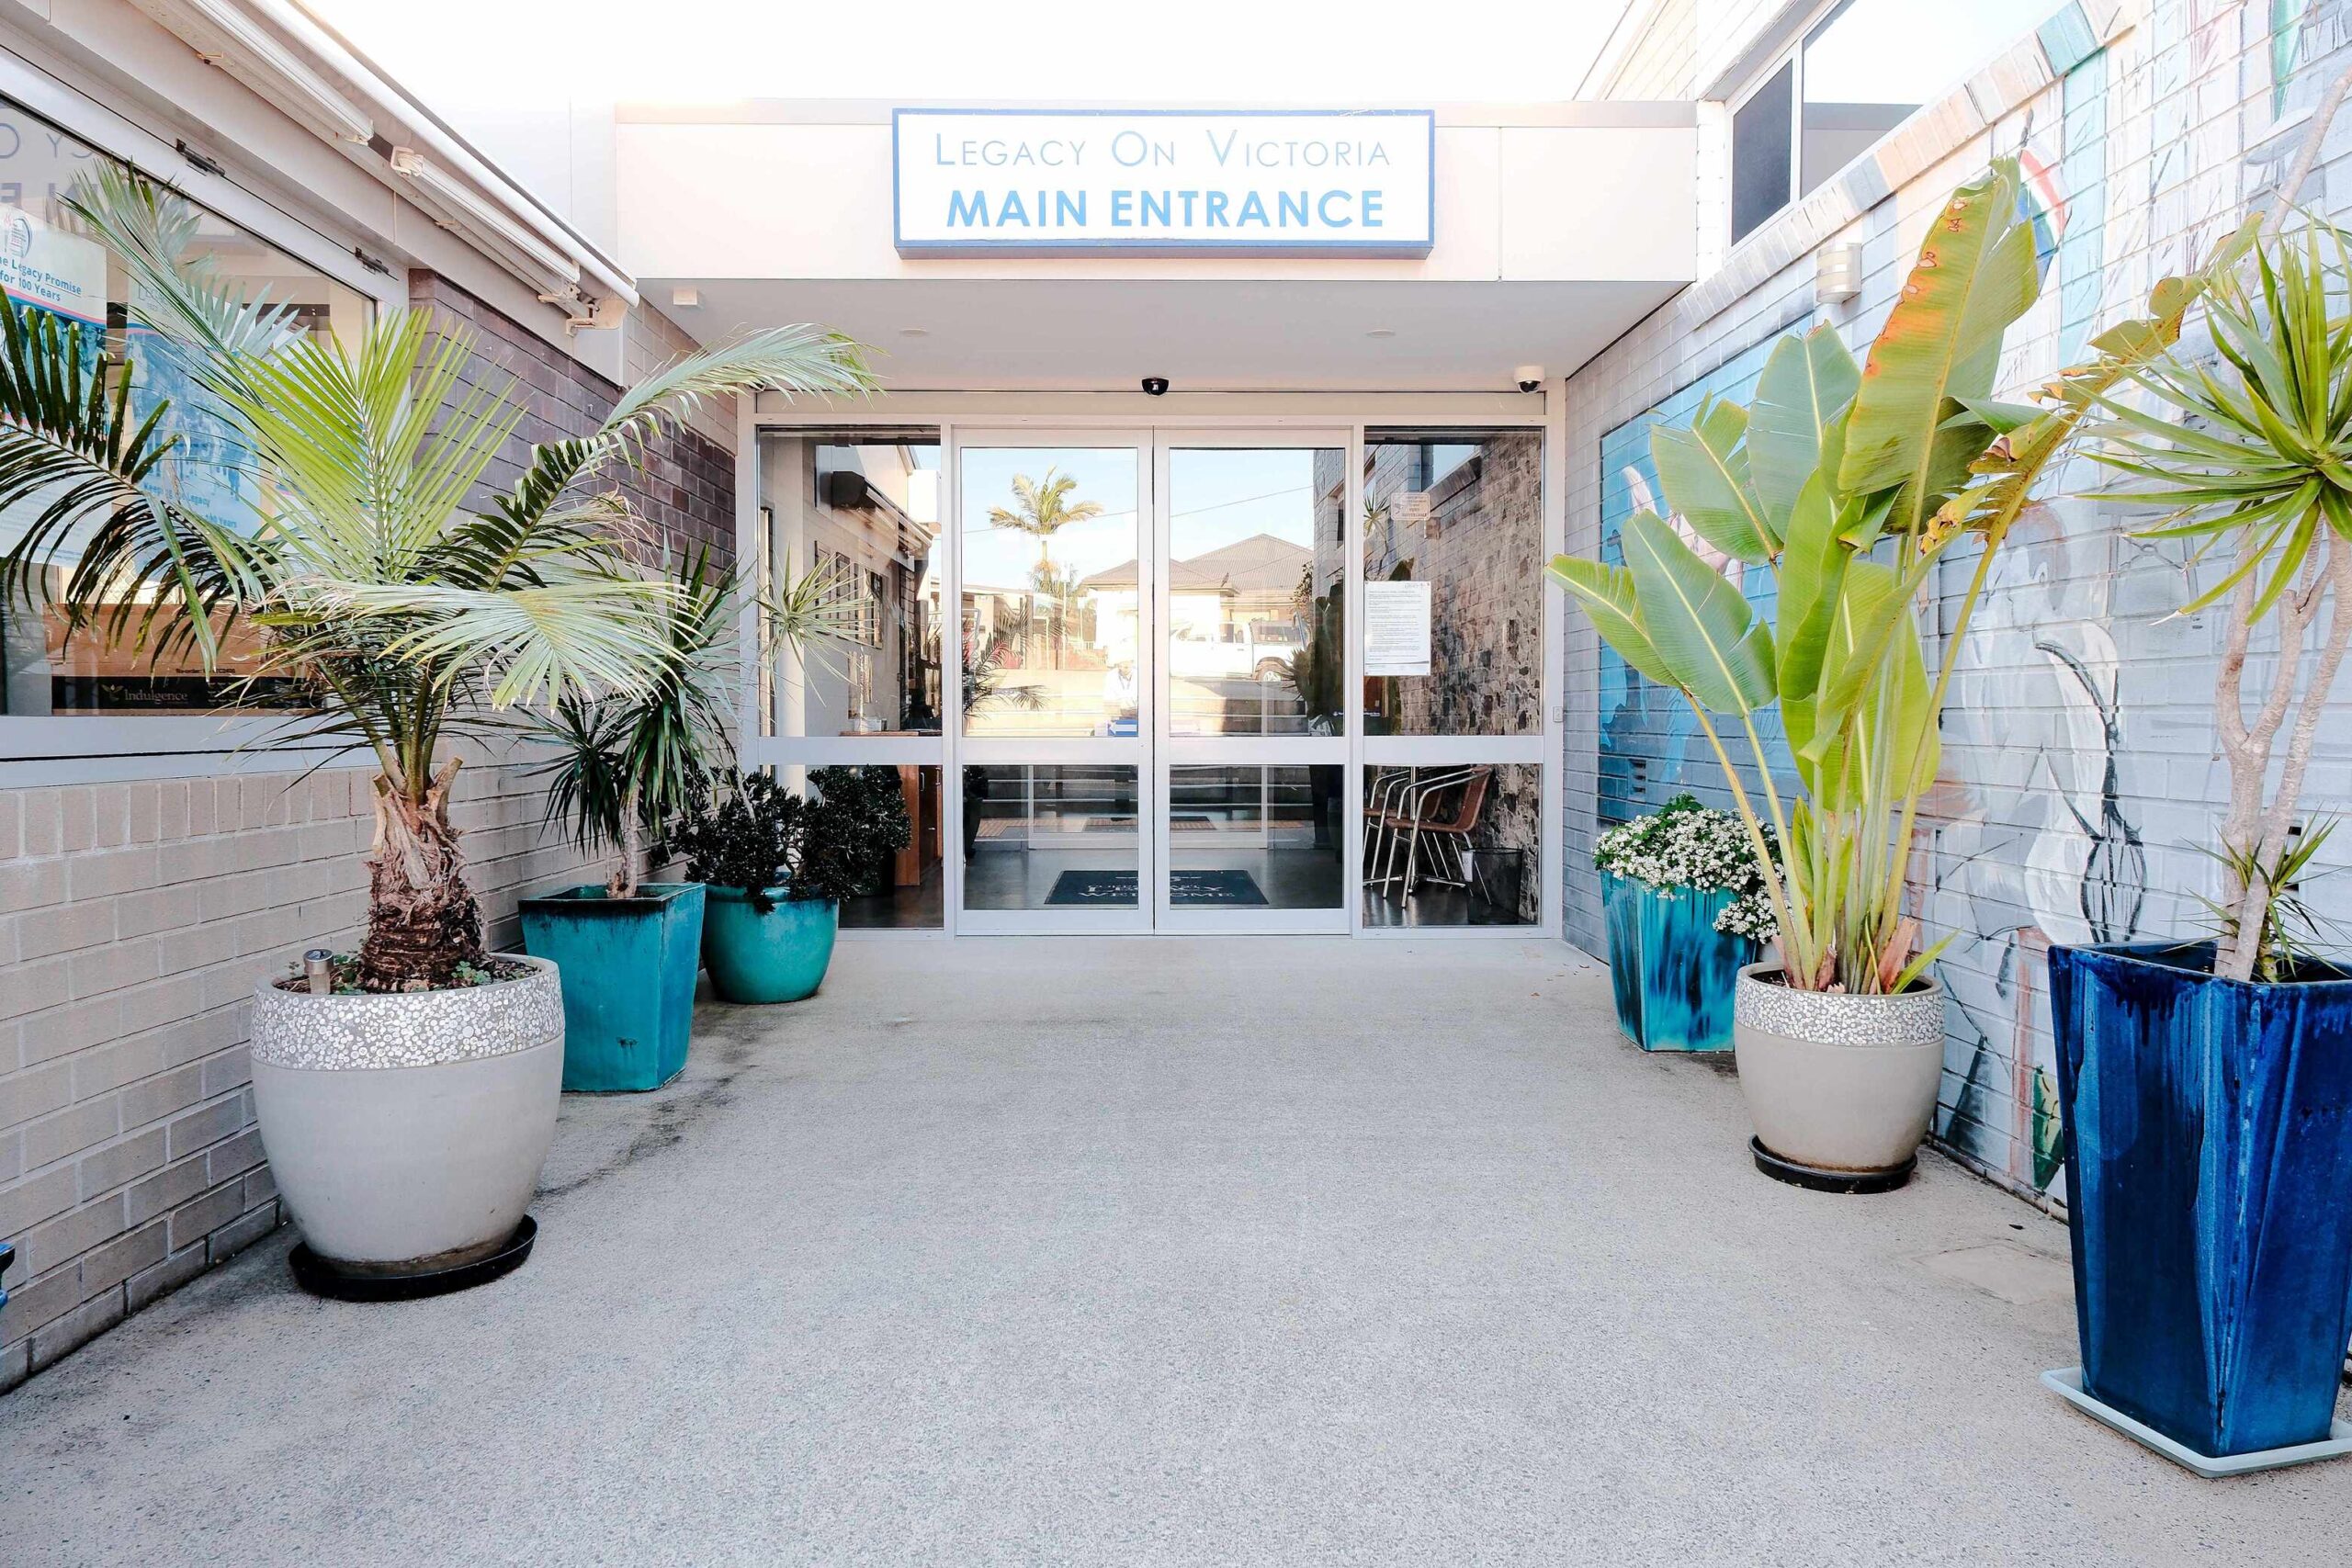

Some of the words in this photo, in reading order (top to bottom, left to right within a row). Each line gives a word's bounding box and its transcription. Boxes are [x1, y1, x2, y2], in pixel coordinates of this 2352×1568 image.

[935, 132, 1087, 167] LEGACY
[1111, 130, 1174, 167] ON
[1205, 129, 1391, 167] VICTORIA
[945, 189, 1088, 228] MAIN
[1111, 189, 1384, 228] ENTRANCE
[0, 270, 15, 284] for
[18, 277, 32, 291] 100
[35, 283, 61, 301] Years
[11, 259, 43, 281] Legacy
[45, 273, 82, 295] Promise
[124, 688, 188, 705] Indulgence
